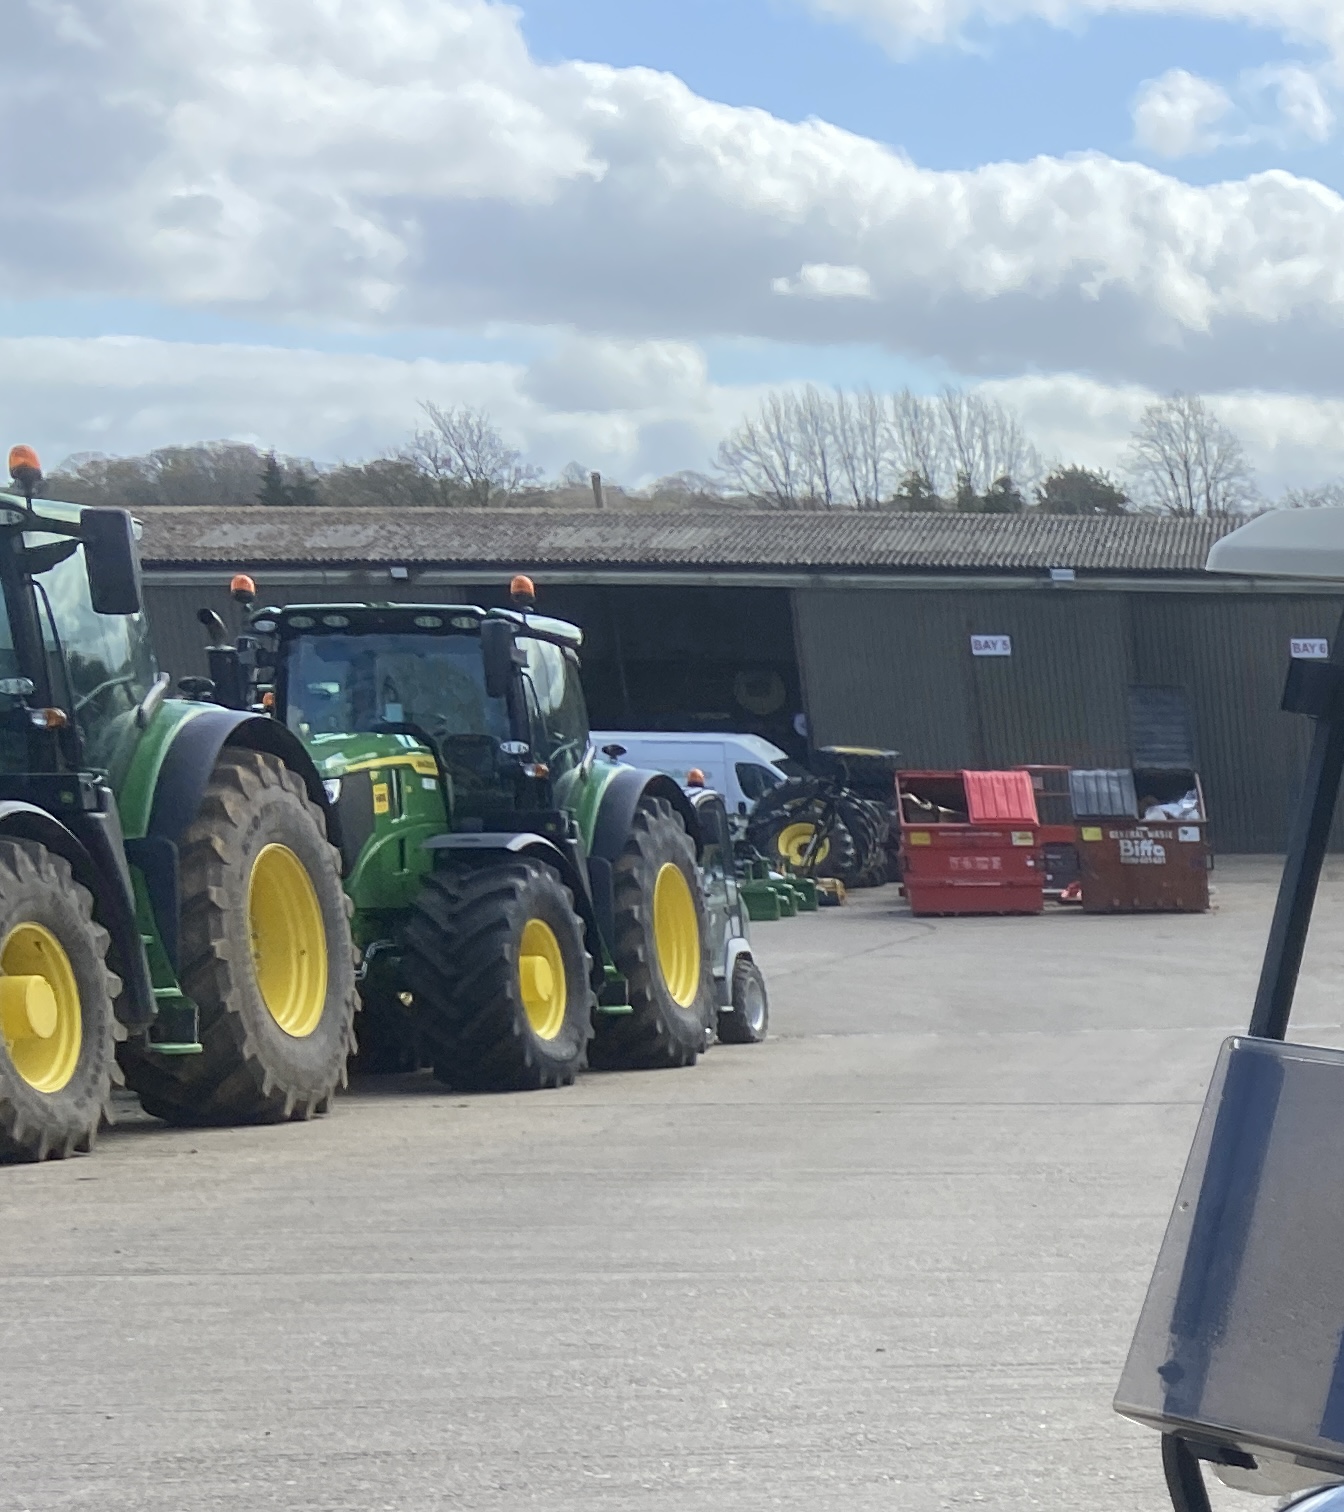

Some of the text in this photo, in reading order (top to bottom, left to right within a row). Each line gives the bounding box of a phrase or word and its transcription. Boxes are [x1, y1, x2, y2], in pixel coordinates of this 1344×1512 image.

[973, 639, 998, 651] BAY
[1292, 642, 1316, 654] BAY
[1119, 839, 1166, 857] Biffa
